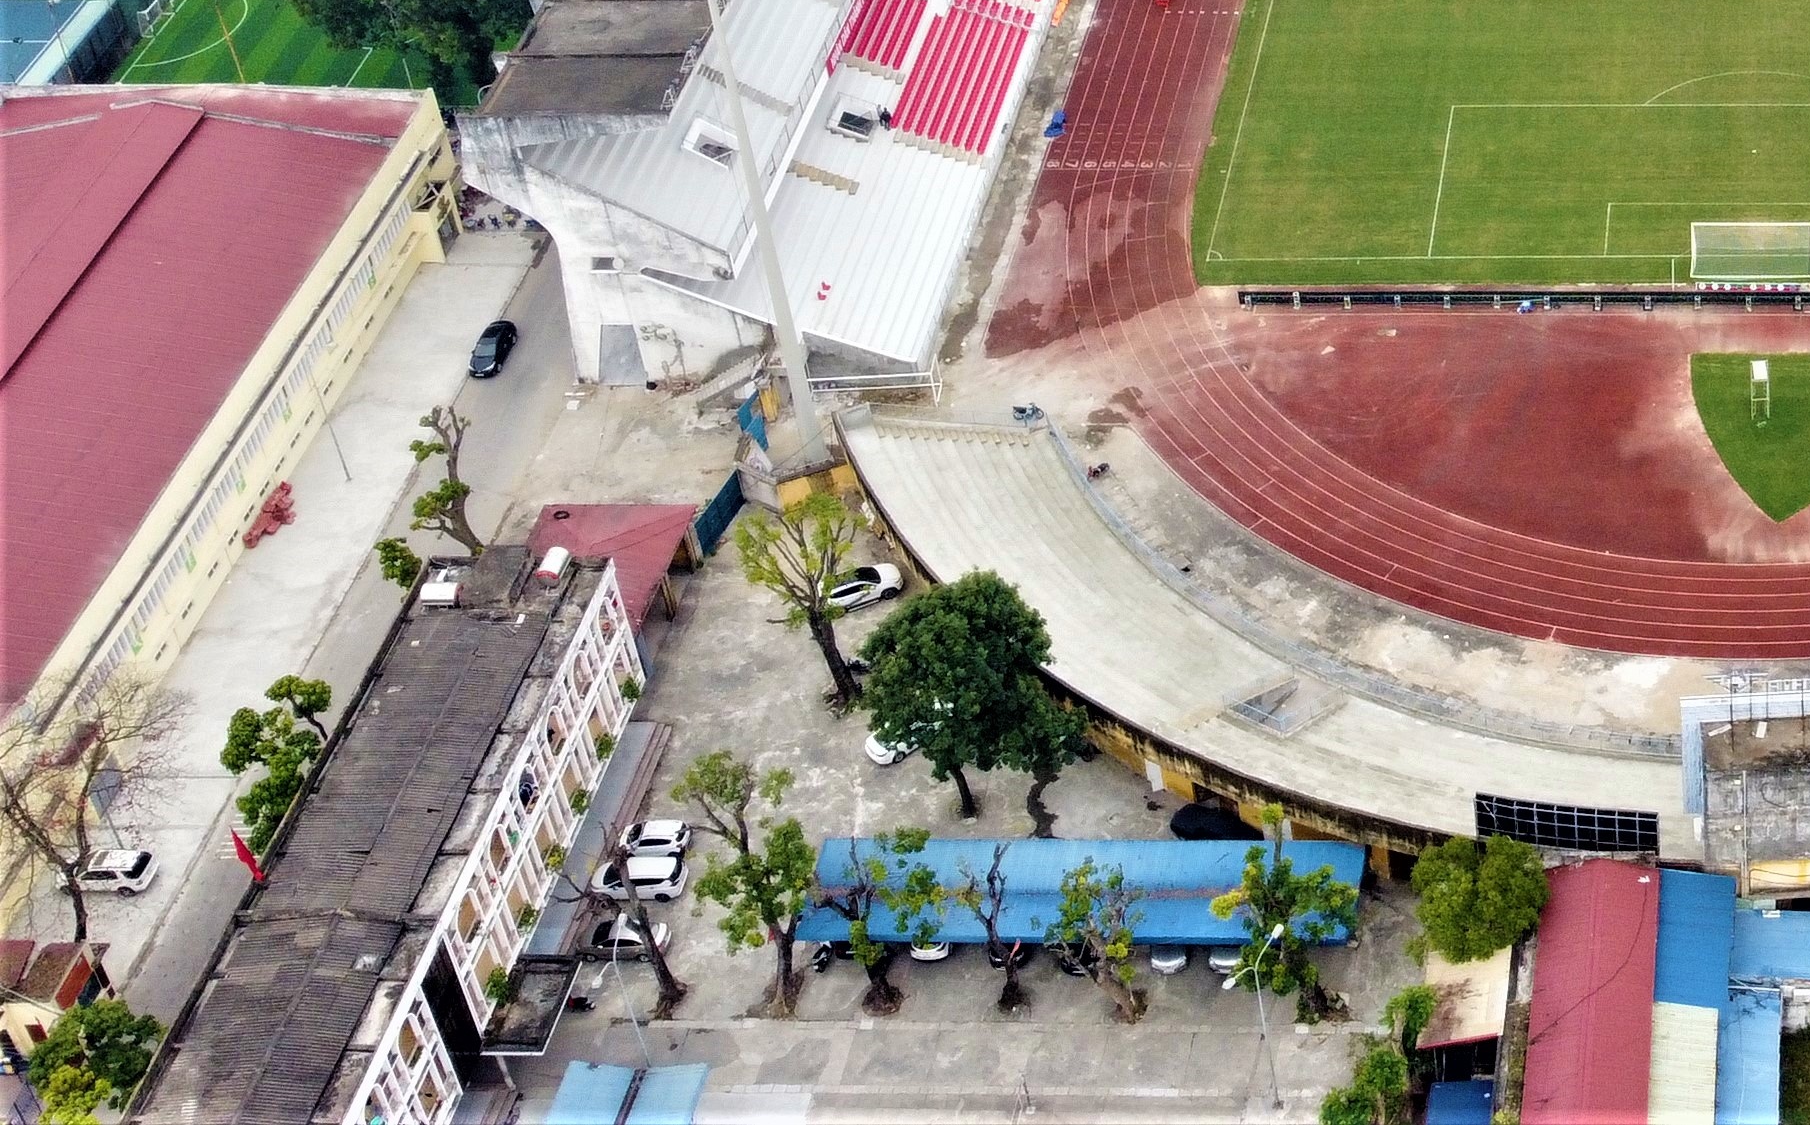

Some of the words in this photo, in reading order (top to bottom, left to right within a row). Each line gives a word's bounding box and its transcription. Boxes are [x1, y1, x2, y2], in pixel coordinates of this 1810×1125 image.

[1047, 160, 1060, 169] 8
[1065, 160, 1079, 169] 7
[1084, 160, 1097, 169] 6
[1103, 160, 1116, 169] 5
[1121, 160, 1134, 169] 4
[1140, 160, 1154, 169] 3
